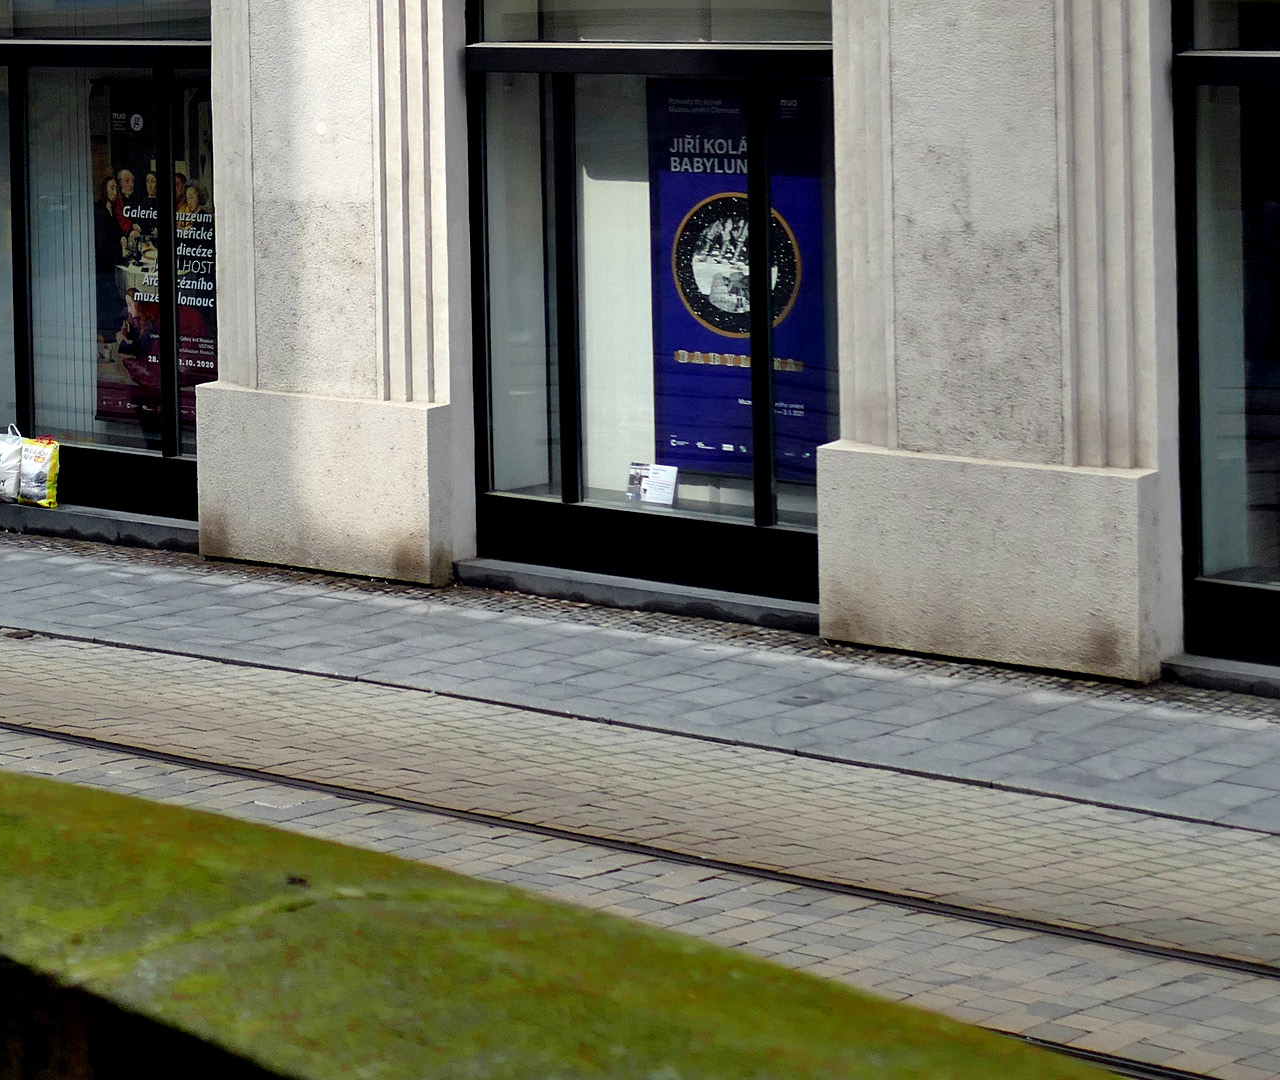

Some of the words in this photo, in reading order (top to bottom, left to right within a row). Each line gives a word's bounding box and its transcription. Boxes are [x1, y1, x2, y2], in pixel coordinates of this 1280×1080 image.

[669, 134, 700, 154] JIŘÍ
[704, 135, 748, 155] KOLÁ
[670, 156, 749, 175] BABYLUN
[122, 205, 158, 220] Galerie
[134, 292, 160, 303] muze
[177, 291, 215, 307] lomouc
